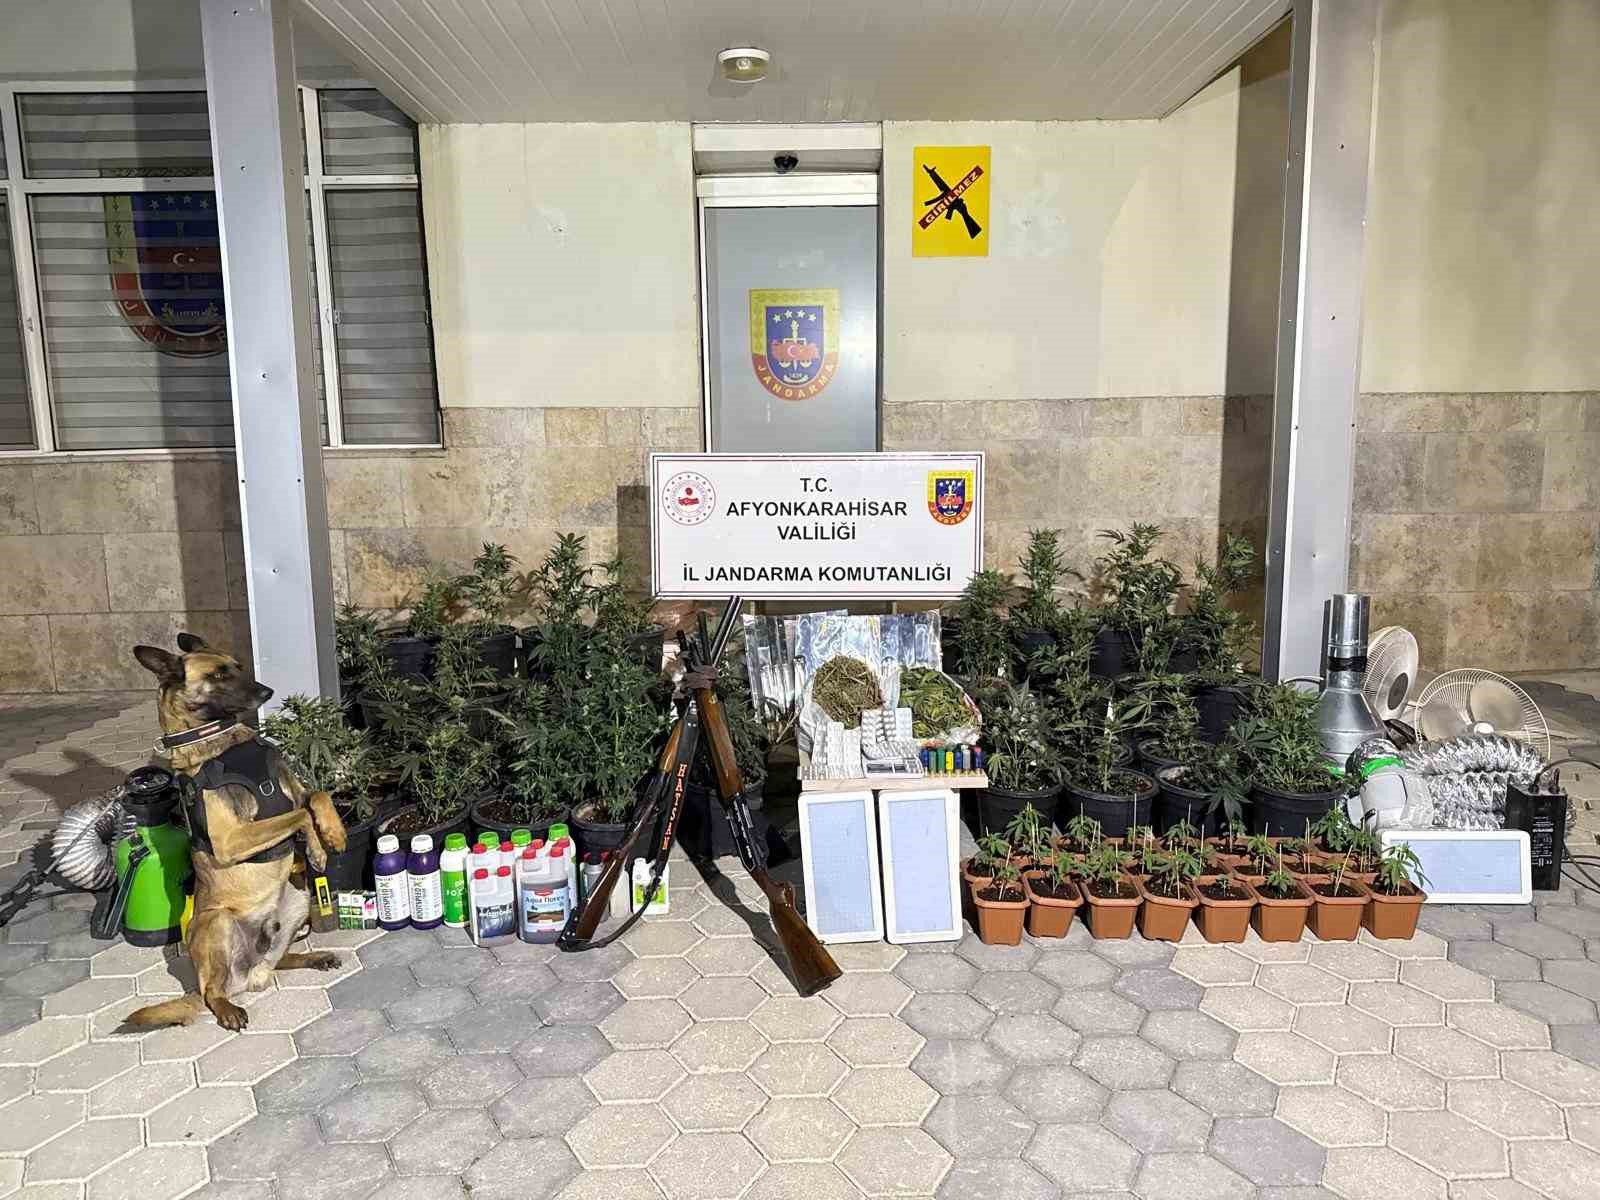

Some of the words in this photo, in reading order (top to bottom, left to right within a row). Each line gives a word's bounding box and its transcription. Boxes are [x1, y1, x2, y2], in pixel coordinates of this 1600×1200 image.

[799, 477, 833, 493] T.C.
[726, 499, 907, 517] AFYONKARAHİSAR
[777, 521, 856, 541] VALİLİĞİ
[683, 562, 699, 581] İL
[704, 565, 812, 582] JANDARMA
[818, 562, 952, 582] KOMUTANLIĞI
